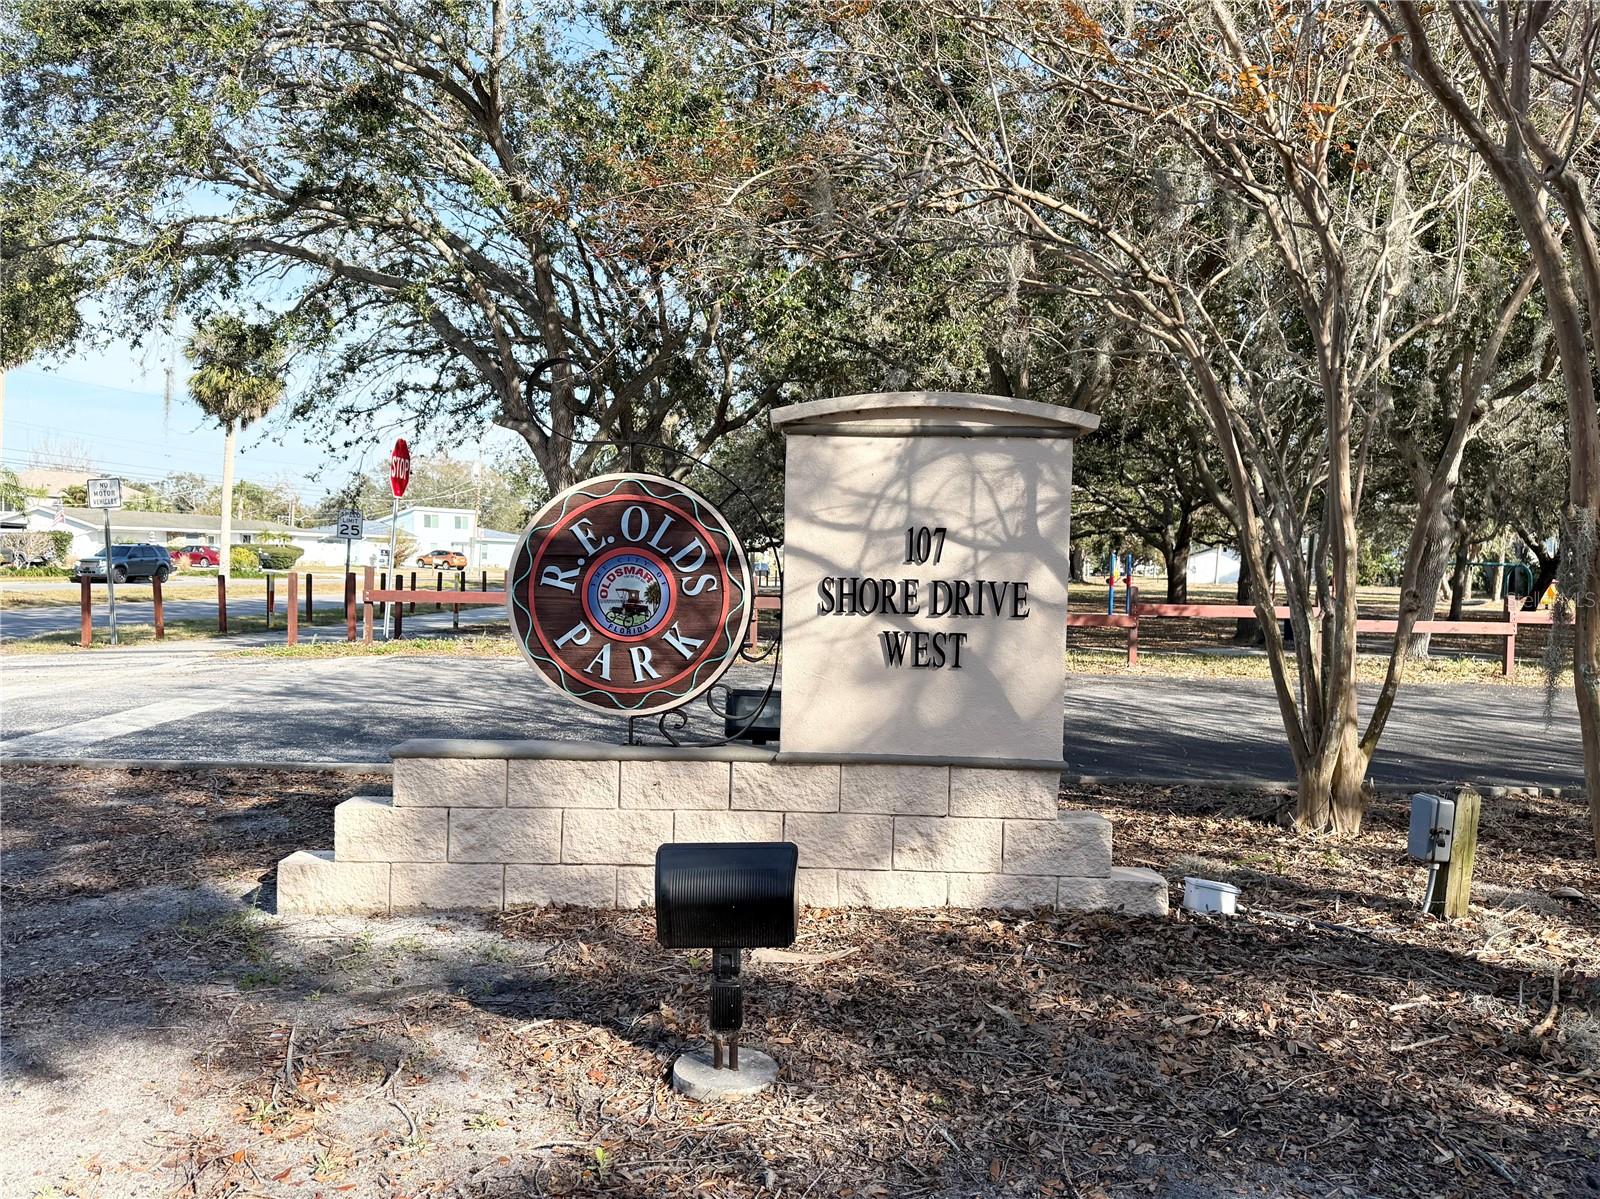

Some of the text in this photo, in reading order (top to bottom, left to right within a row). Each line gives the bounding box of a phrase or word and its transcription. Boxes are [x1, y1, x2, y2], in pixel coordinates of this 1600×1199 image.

[391, 456, 410, 480] STOP
[340, 524, 360, 536] 25
[905, 526, 947, 564] 107
[617, 556, 649, 566] CITY
[620, 505, 718, 597] OLDS
[600, 566, 654, 598] OLDSMAR
[820, 576, 1030, 618] SHORE DRIVE
[607, 623, 650, 634] FLORIDA
[553, 620, 705, 683] PARK
[881, 630, 968, 669] WEST
